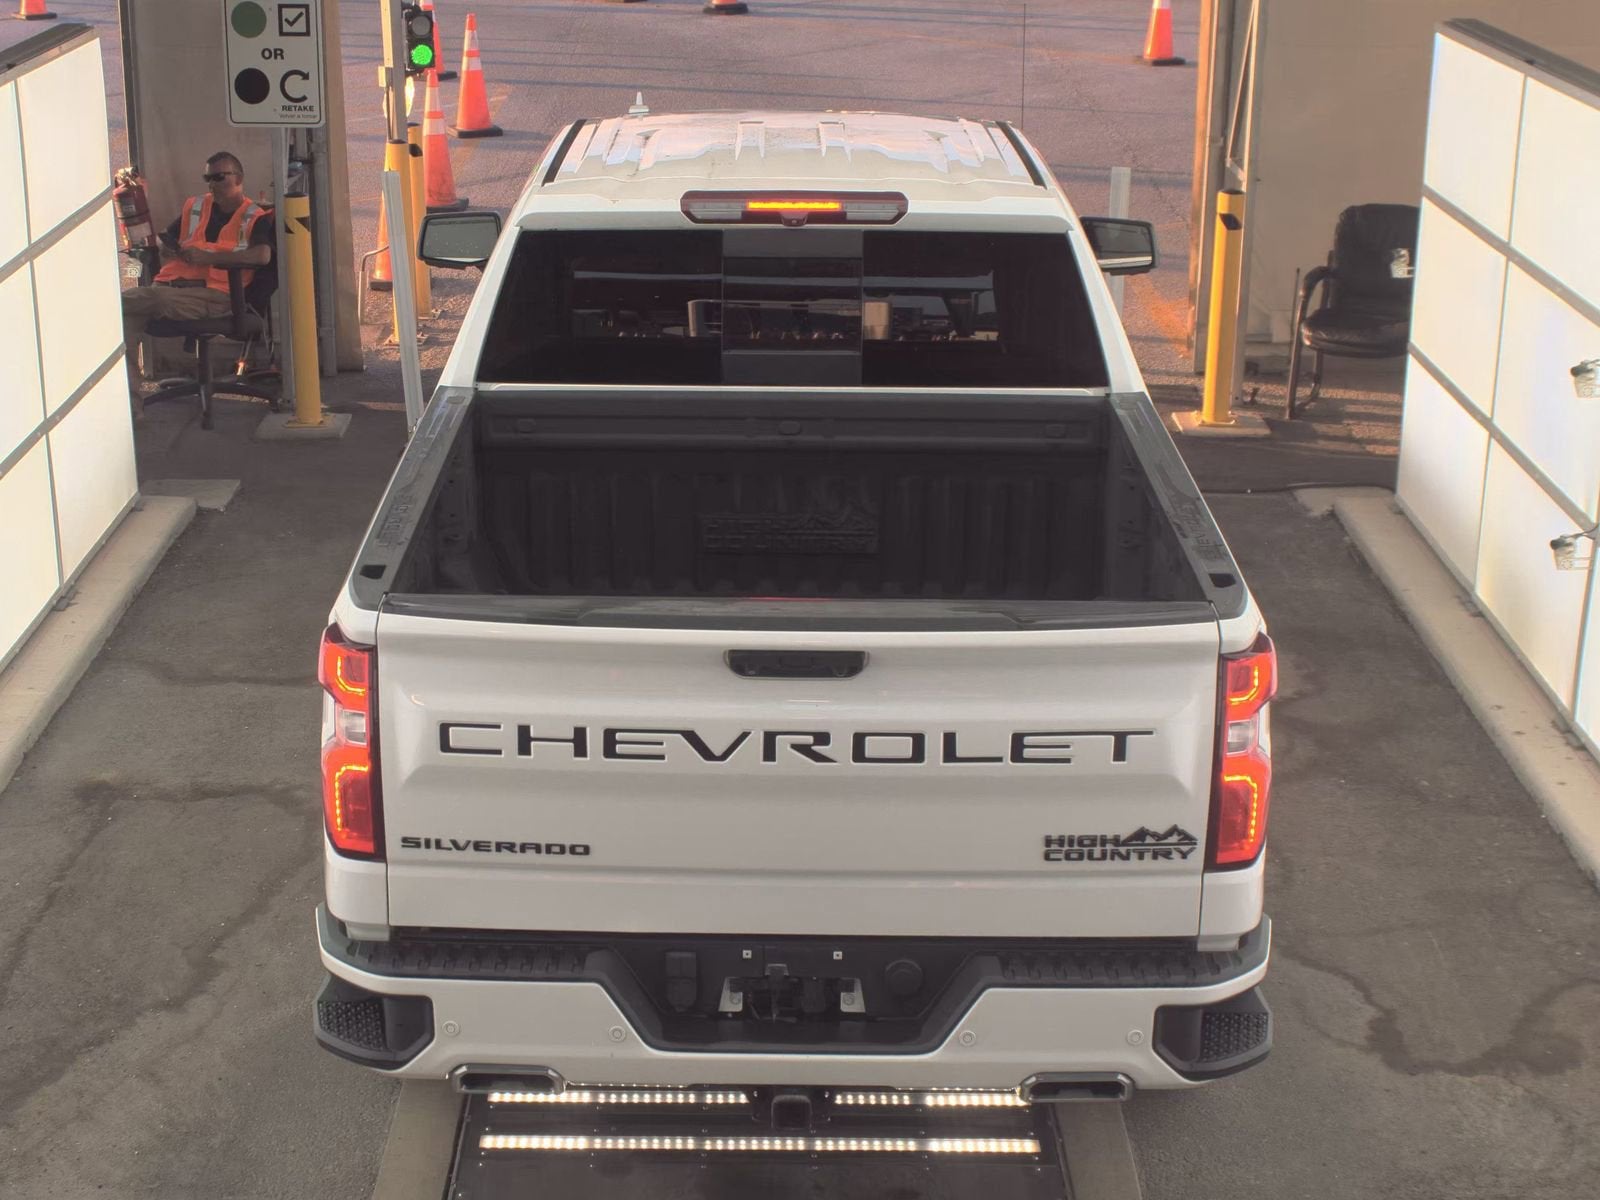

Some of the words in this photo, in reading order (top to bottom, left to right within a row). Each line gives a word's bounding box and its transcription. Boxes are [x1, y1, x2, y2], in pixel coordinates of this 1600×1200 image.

[261, 48, 284, 60] OR
[439, 721, 1154, 764] CHEVROLET
[401, 836, 591, 856] SILVERADO
[1044, 834, 1121, 848] HIGH
[1044, 847, 1197, 861] COUNTRY
